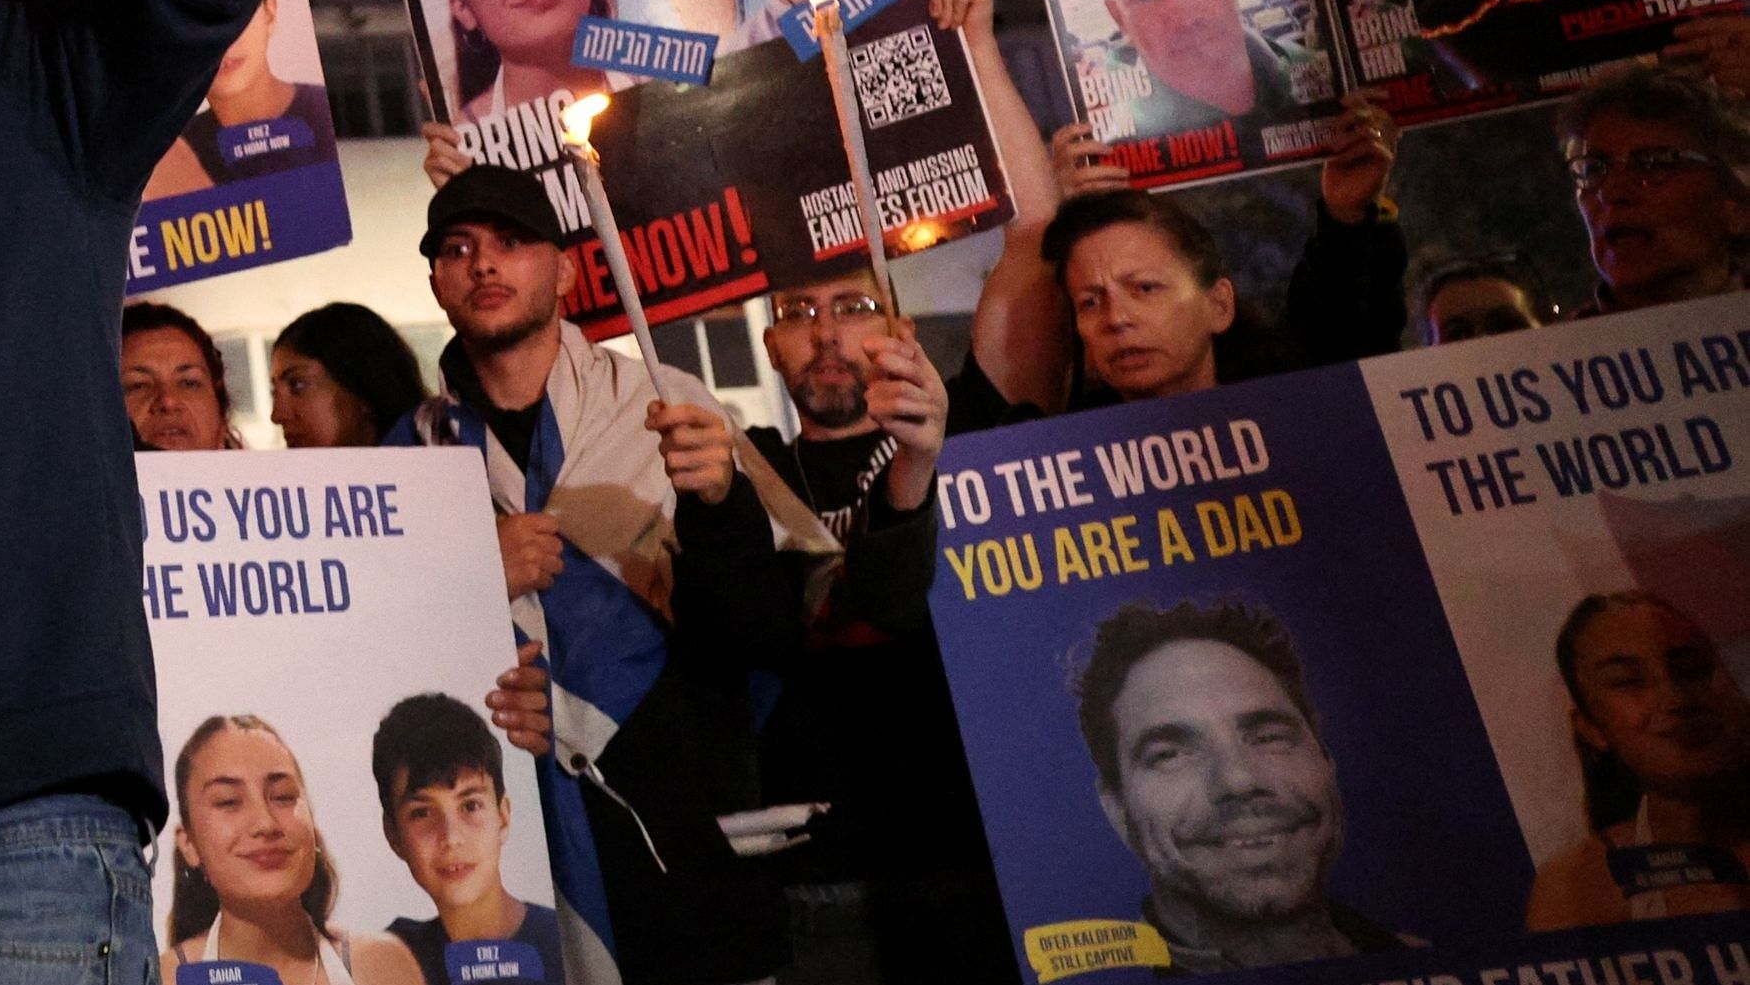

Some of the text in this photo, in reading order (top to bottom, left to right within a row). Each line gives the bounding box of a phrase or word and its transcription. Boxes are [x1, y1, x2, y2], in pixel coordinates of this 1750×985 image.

[583, 24, 707, 76] חזרה הביתה
[877, 165, 910, 196] AND
[908, 144, 979, 186] MISSING
[1166, 119, 1240, 167] NOW!
[160, 199, 273, 271] NOW!
[808, 167, 991, 253] FAMIES FORUM
[1400, 382, 1473, 442] TO
[1476, 368, 1551, 430] US
[1551, 347, 1665, 415] YOU
[937, 469, 993, 530] TO
[994, 450, 1094, 518] THE
[1095, 418, 1270, 500] WORLD
[1426, 416, 1733, 516] THE WORLD
[160, 488, 217, 543] US
[224, 486, 312, 541] YOU
[325, 484, 404, 538] ARE
[943, 488, 1303, 601] YOU ARE A DAD
[143, 559, 351, 620] HE WORLD
